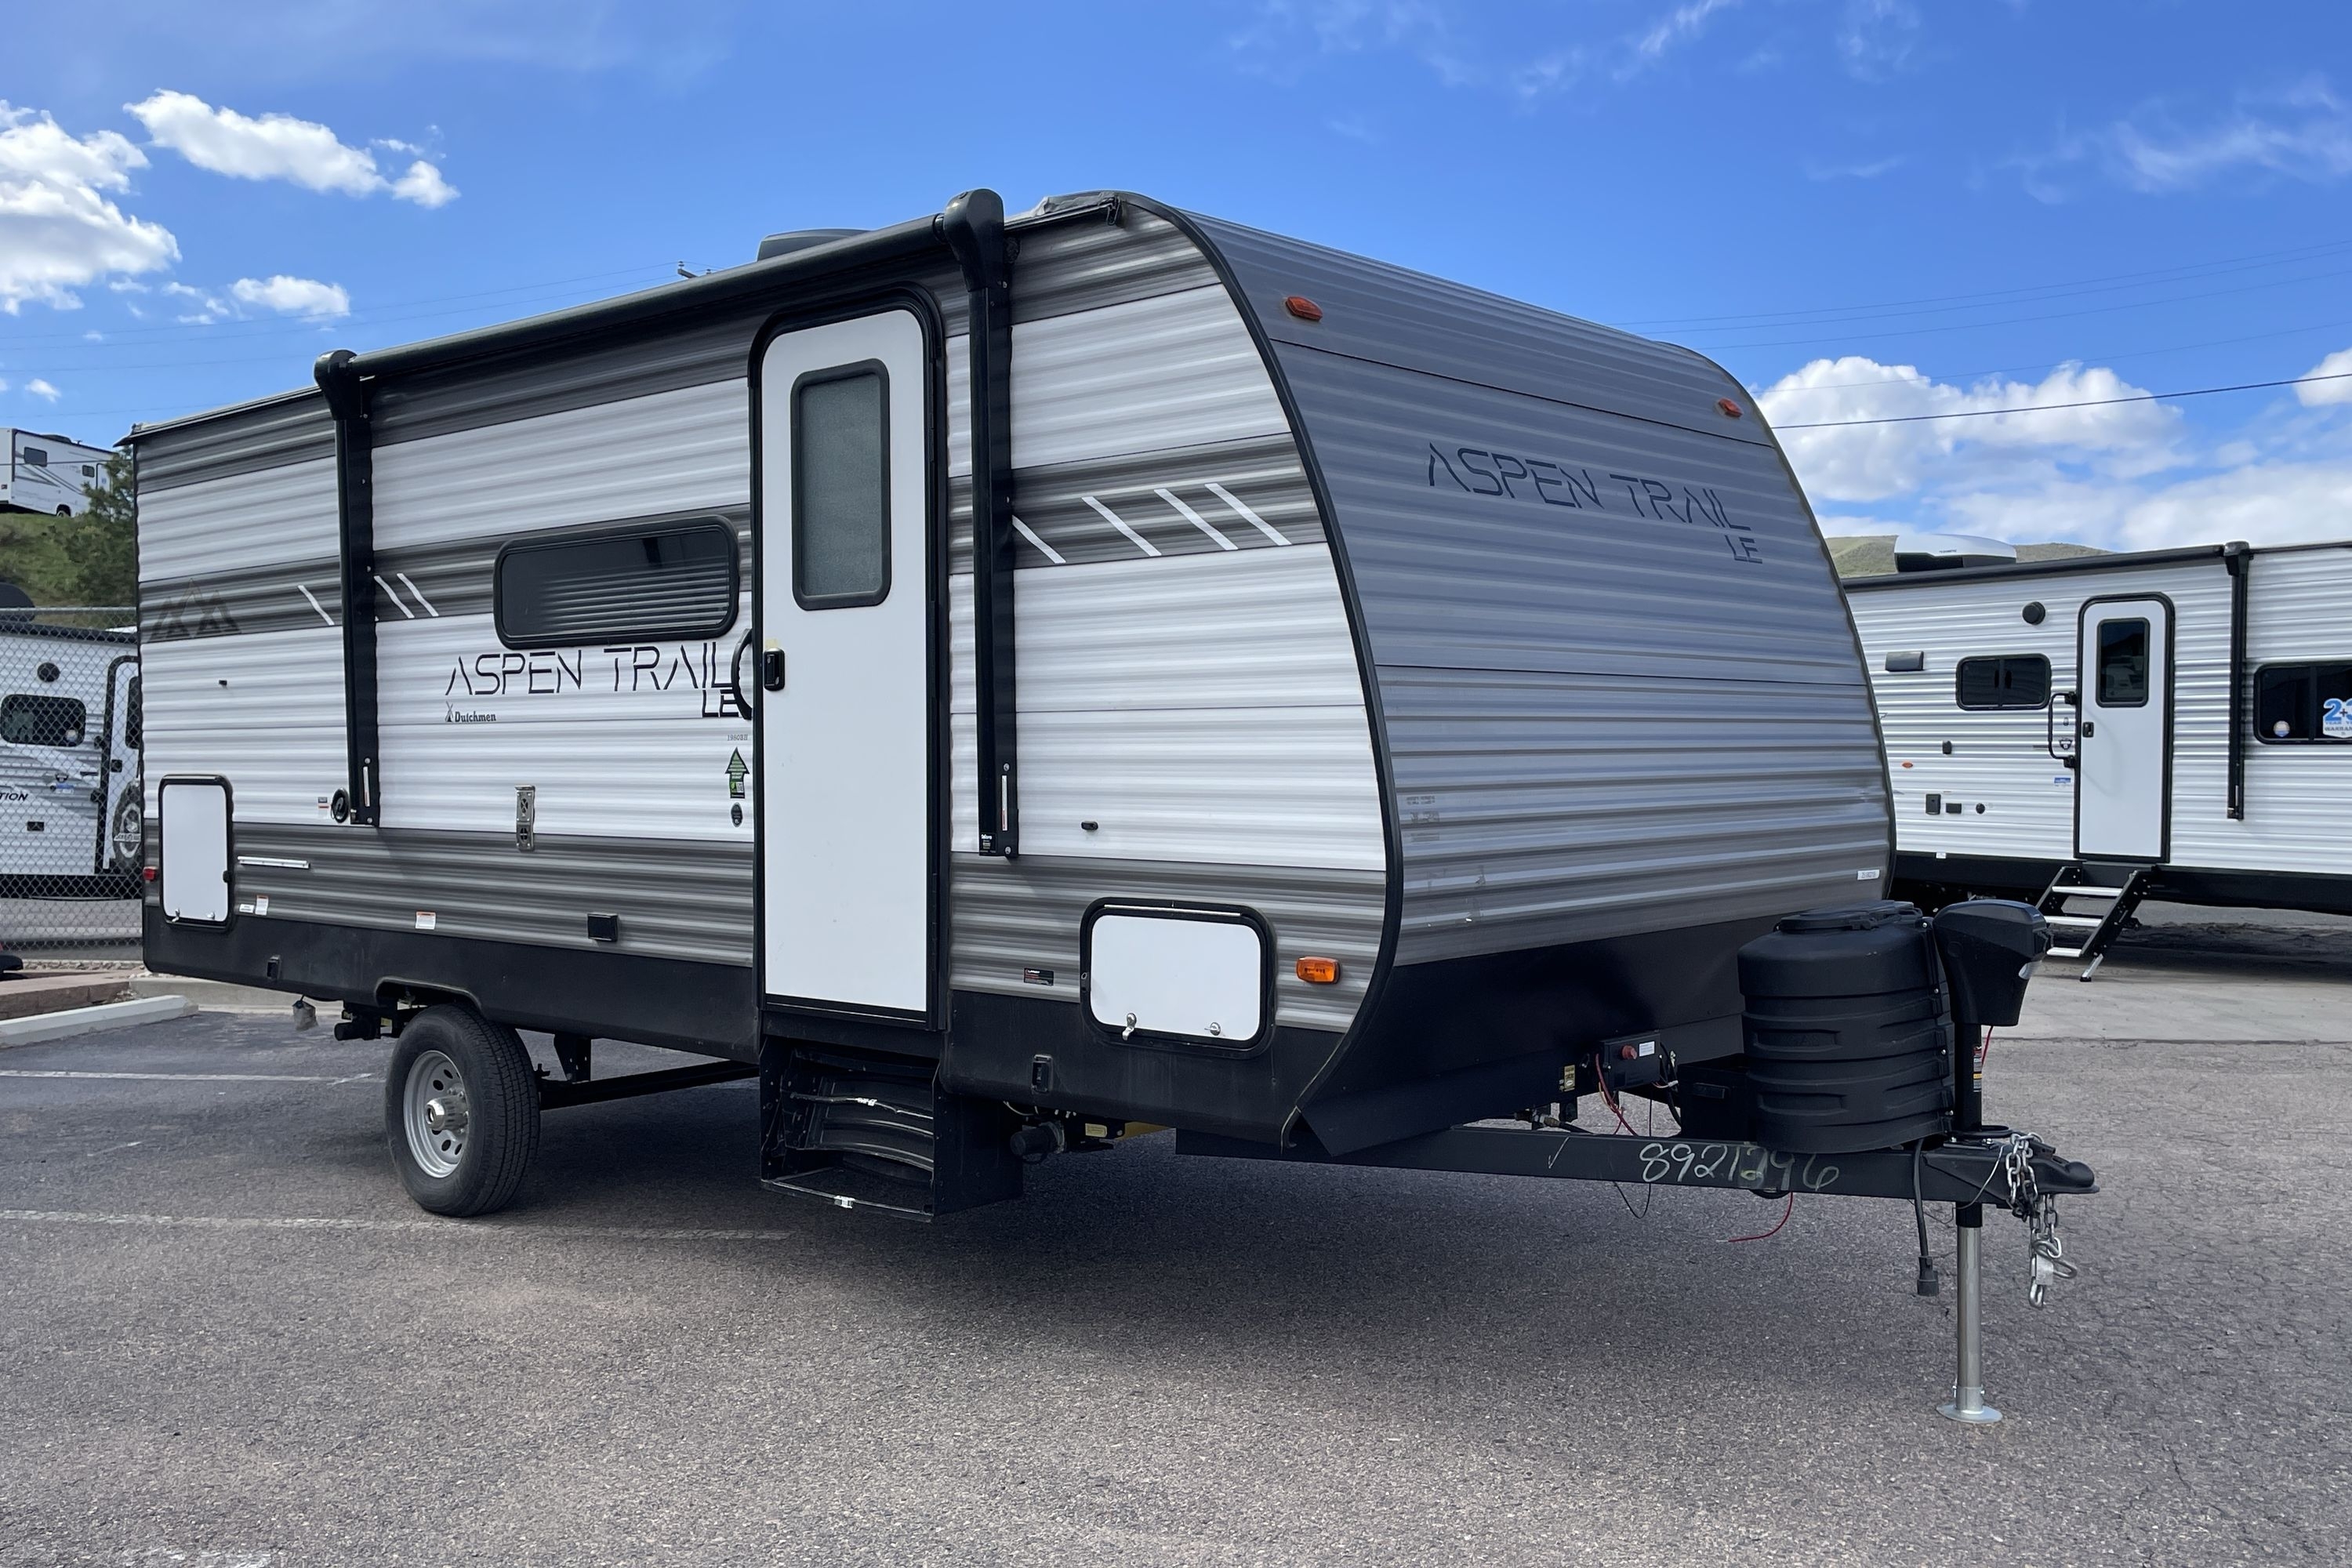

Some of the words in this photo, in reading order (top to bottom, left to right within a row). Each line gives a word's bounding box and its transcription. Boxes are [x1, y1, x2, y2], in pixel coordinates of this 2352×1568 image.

[1428, 442, 1604, 509] ASPEN
[1610, 474, 1751, 531] TRAIL
[1724, 535, 1763, 564] LE
[445, 649, 583, 696] ASPEN
[603, 641, 733, 691] TRAIL
[455, 711, 496, 723] Dutchmen
[702, 690, 739, 717] LE
